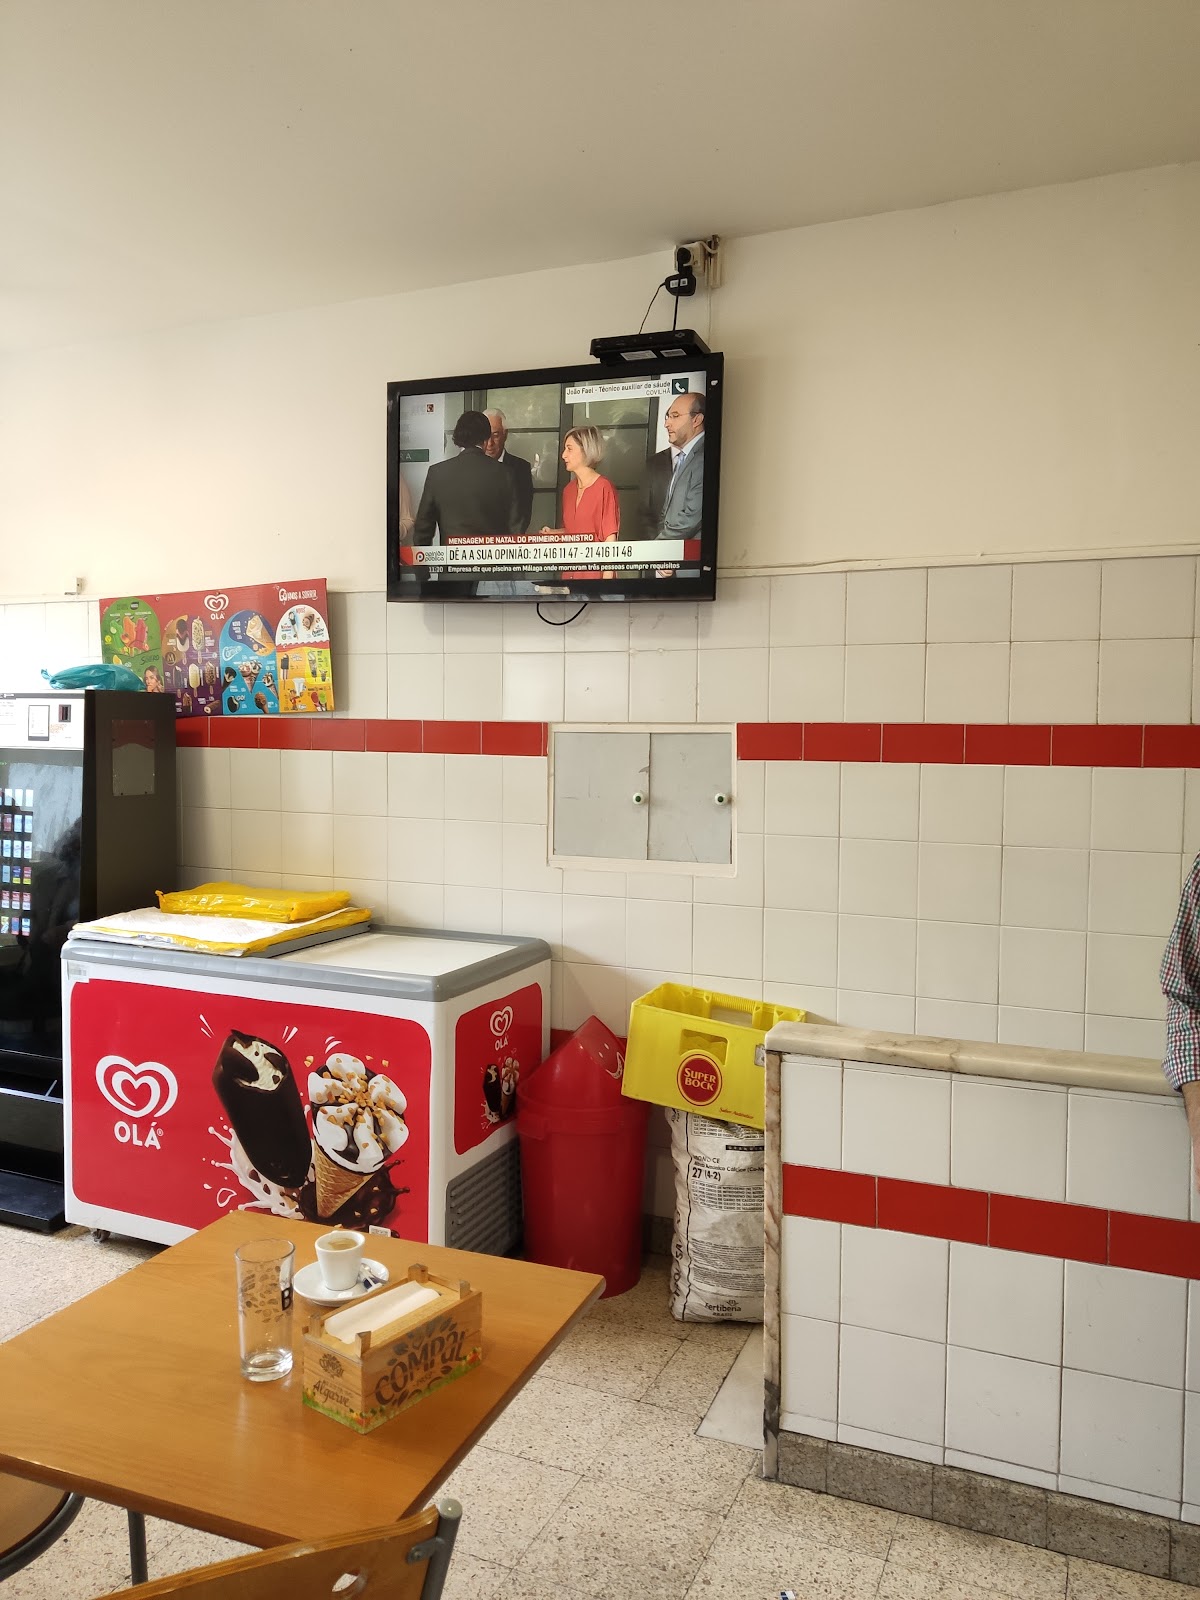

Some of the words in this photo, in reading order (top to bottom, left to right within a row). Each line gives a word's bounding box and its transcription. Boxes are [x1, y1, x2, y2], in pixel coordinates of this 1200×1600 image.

[448, 536, 484, 544] MENSAGEM
[495, 536, 516, 544] NATAL
[516, 535, 526, 543] DO
[527, 534, 594, 542] PRIMEIRO-MINISTRO
[449, 547, 460, 560] DÊ
[461, 549, 468, 560] A
[468, 549, 475, 560] A
[476, 549, 493, 560] SUA
[494, 546, 532, 560] OPINIÃO:
[533, 548, 542, 559] 21
[543, 548, 558, 559] 416
[559, 547, 566, 558] 11
[568, 547, 578, 558] 47
[585, 546, 593, 558] 21
[596, 546, 610, 558] 416
[612, 546, 620, 558] 11
[622, 546, 632, 557] 48
[522, 564, 542, 572] Málaga
[650, 562, 680, 570] requisitos
[495, 1033, 508, 1050] OLÁ
[684, 1068, 716, 1084] SUPER
[684, 1078, 714, 1091] BOCK
[114, 1120, 162, 1150] OLÁ
[692, 1166, 702, 1178] 27
[704, 1170, 721, 1182] (4-2)
[313, 1380, 350, 1408] Algarve
